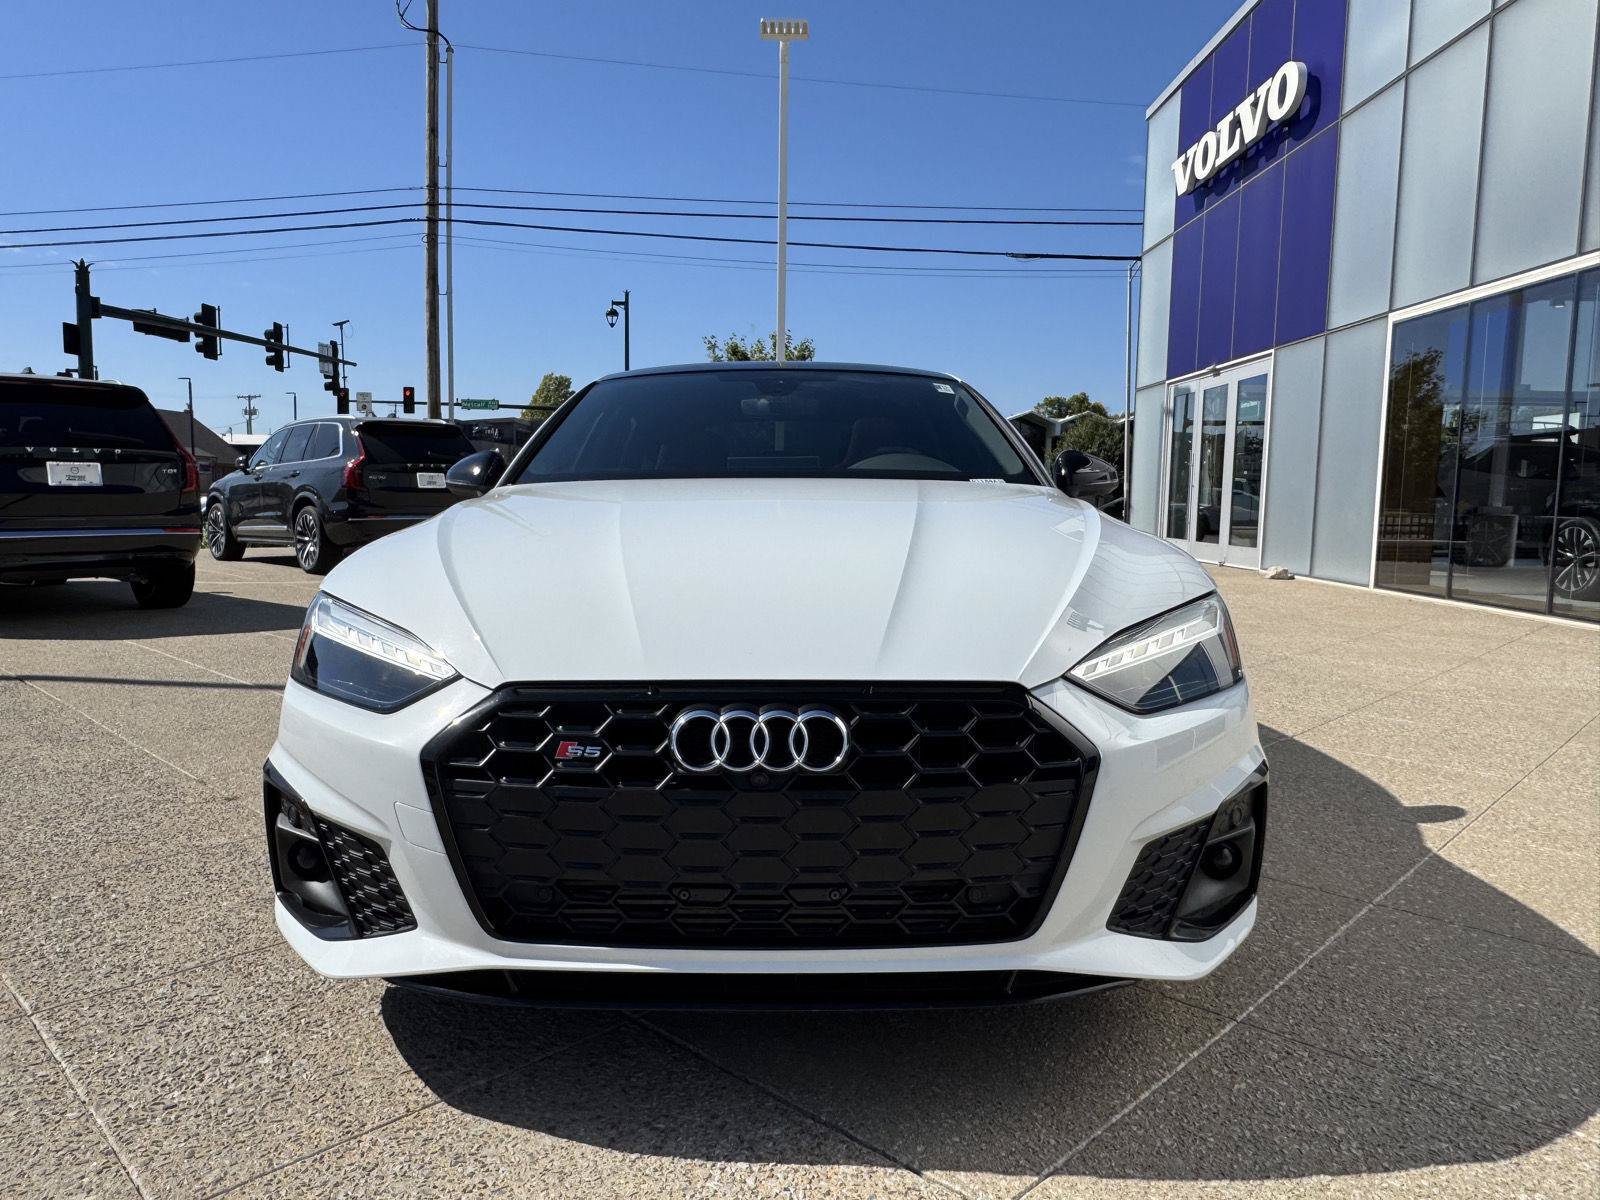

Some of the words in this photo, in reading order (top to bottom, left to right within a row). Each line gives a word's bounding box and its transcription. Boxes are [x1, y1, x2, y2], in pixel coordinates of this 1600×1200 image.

[1171, 61, 1308, 197] VOLVO
[25, 446, 122, 455] VOLVO
[565, 745, 602, 758] S5
